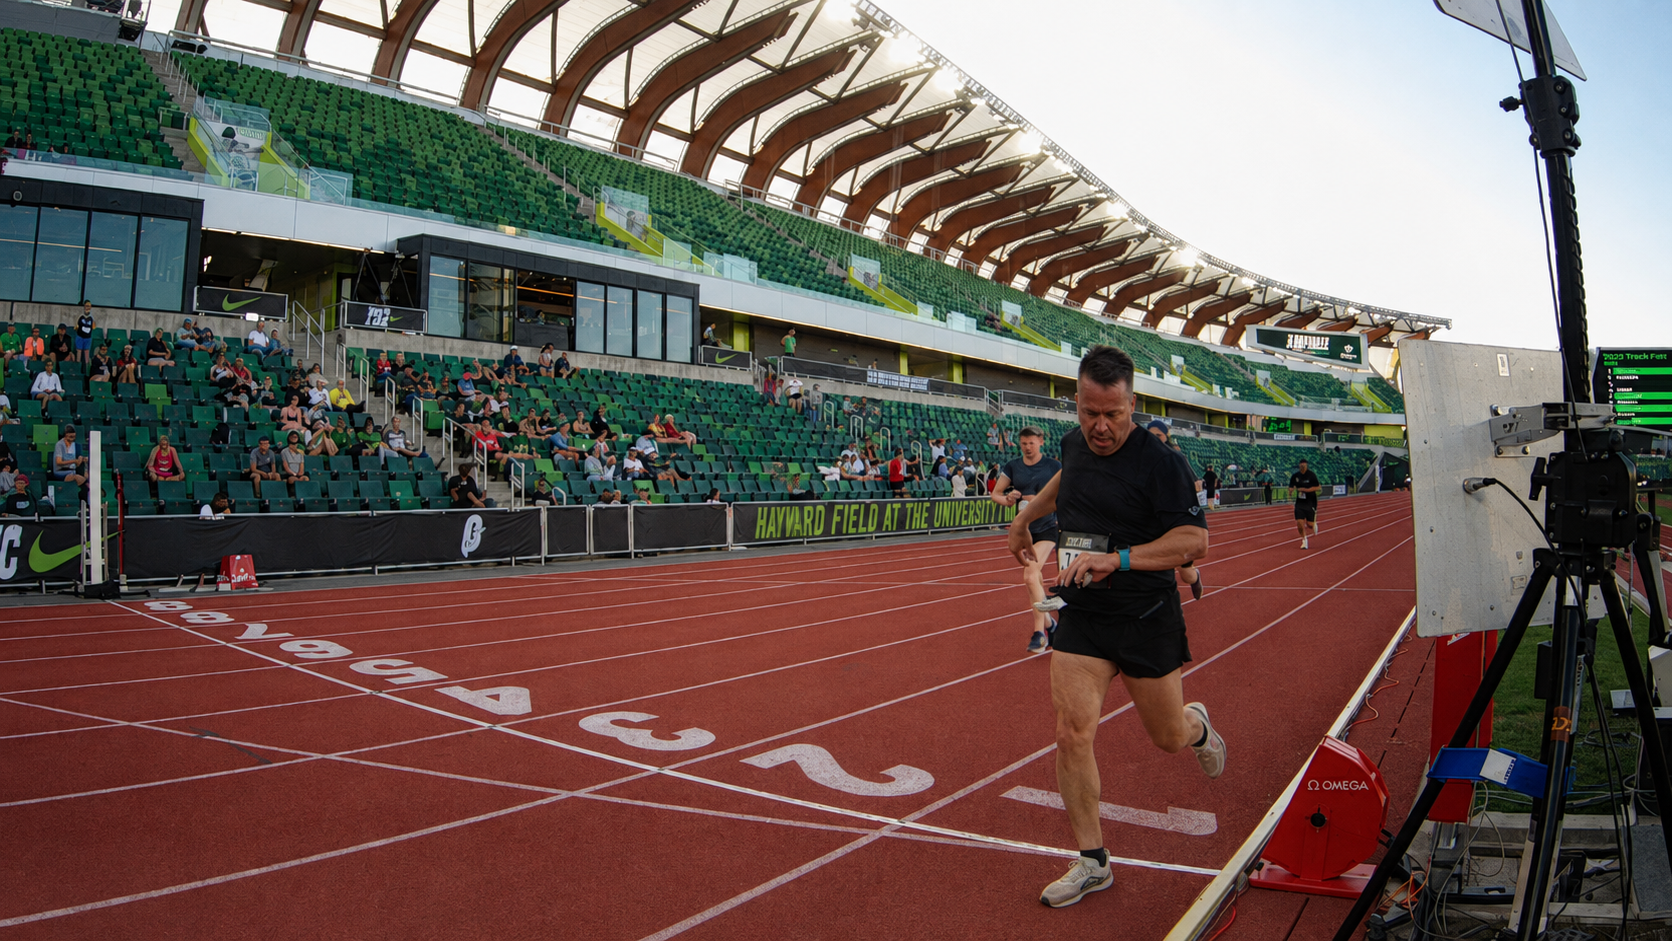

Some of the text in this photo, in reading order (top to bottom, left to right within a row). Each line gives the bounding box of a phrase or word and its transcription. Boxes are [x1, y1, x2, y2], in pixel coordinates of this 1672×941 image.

[755, 505, 826, 539] HAYWARD
[831, 503, 879, 535] FIELD
[882, 502, 902, 532] AT
[905, 502, 930, 530] THE
[933, 499, 998, 528] UNIVERSITY
[234, 623, 294, 640] 7
[279, 640, 353, 659] 6
[349, 659, 449, 685] 5
[434, 686, 532, 715] 4
[578, 711, 716, 751] 3
[739, 744, 935, 797] 2
[1322, 780, 1369, 791] OMEGA
